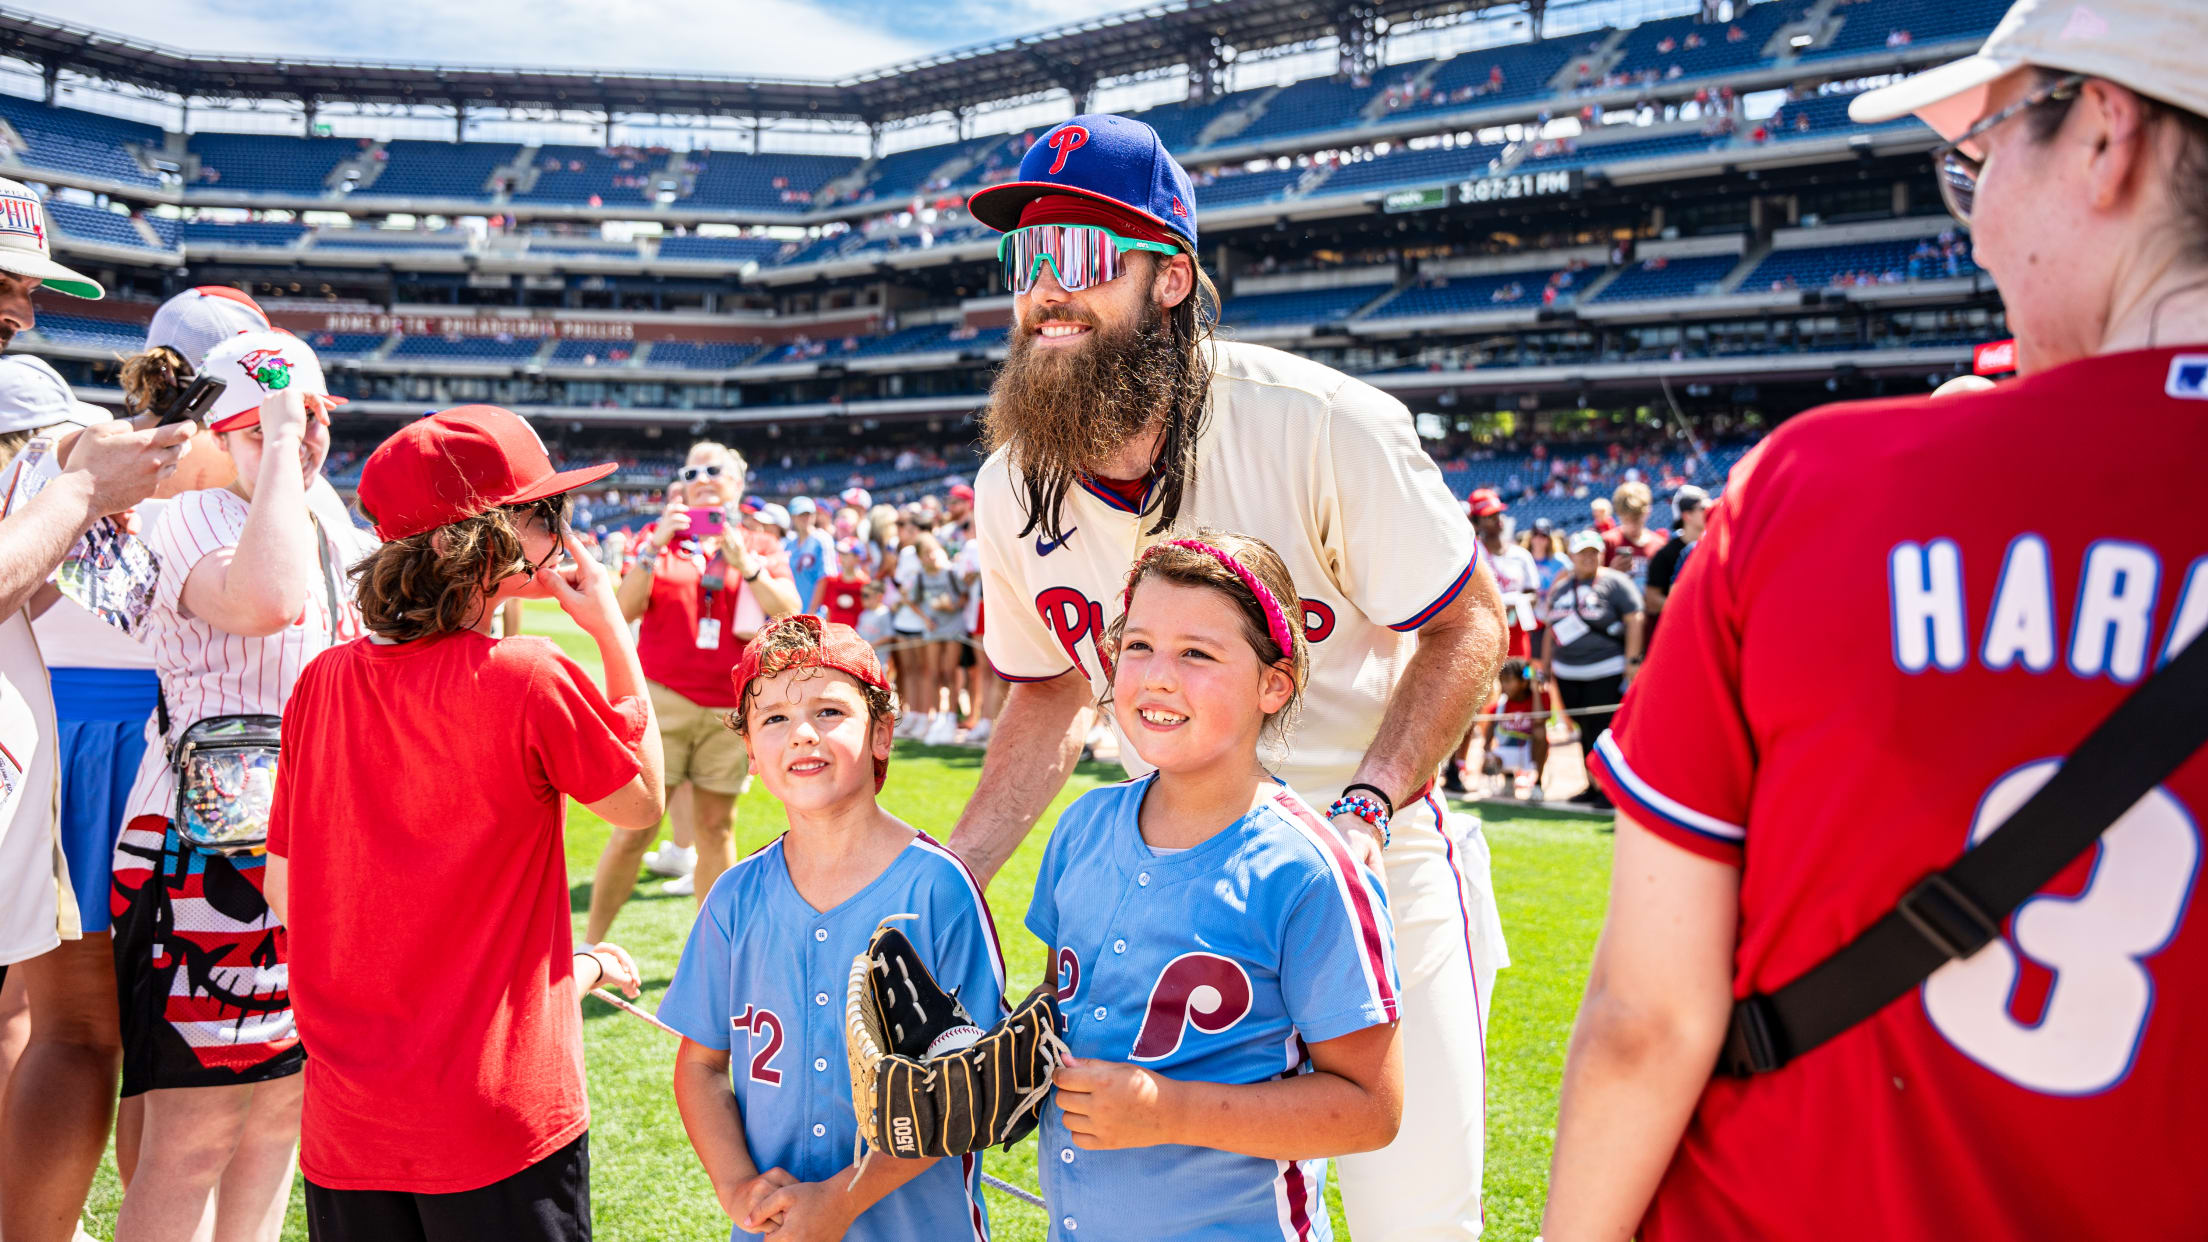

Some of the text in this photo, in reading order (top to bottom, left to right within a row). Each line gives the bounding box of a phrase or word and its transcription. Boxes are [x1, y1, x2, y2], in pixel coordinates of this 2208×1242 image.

[1048, 125, 1090, 175] P
[1536, 170, 1570, 195] PM
[326, 314, 373, 331] HOME
[405, 317, 434, 333] TH
[441, 318, 556, 336] PHILADELPHIA
[562, 321, 634, 339] PHILLIES
[1919, 755, 2205, 1100] 3
[1127, 951, 1254, 1062] P
[892, 1116, 916, 1153] A500
